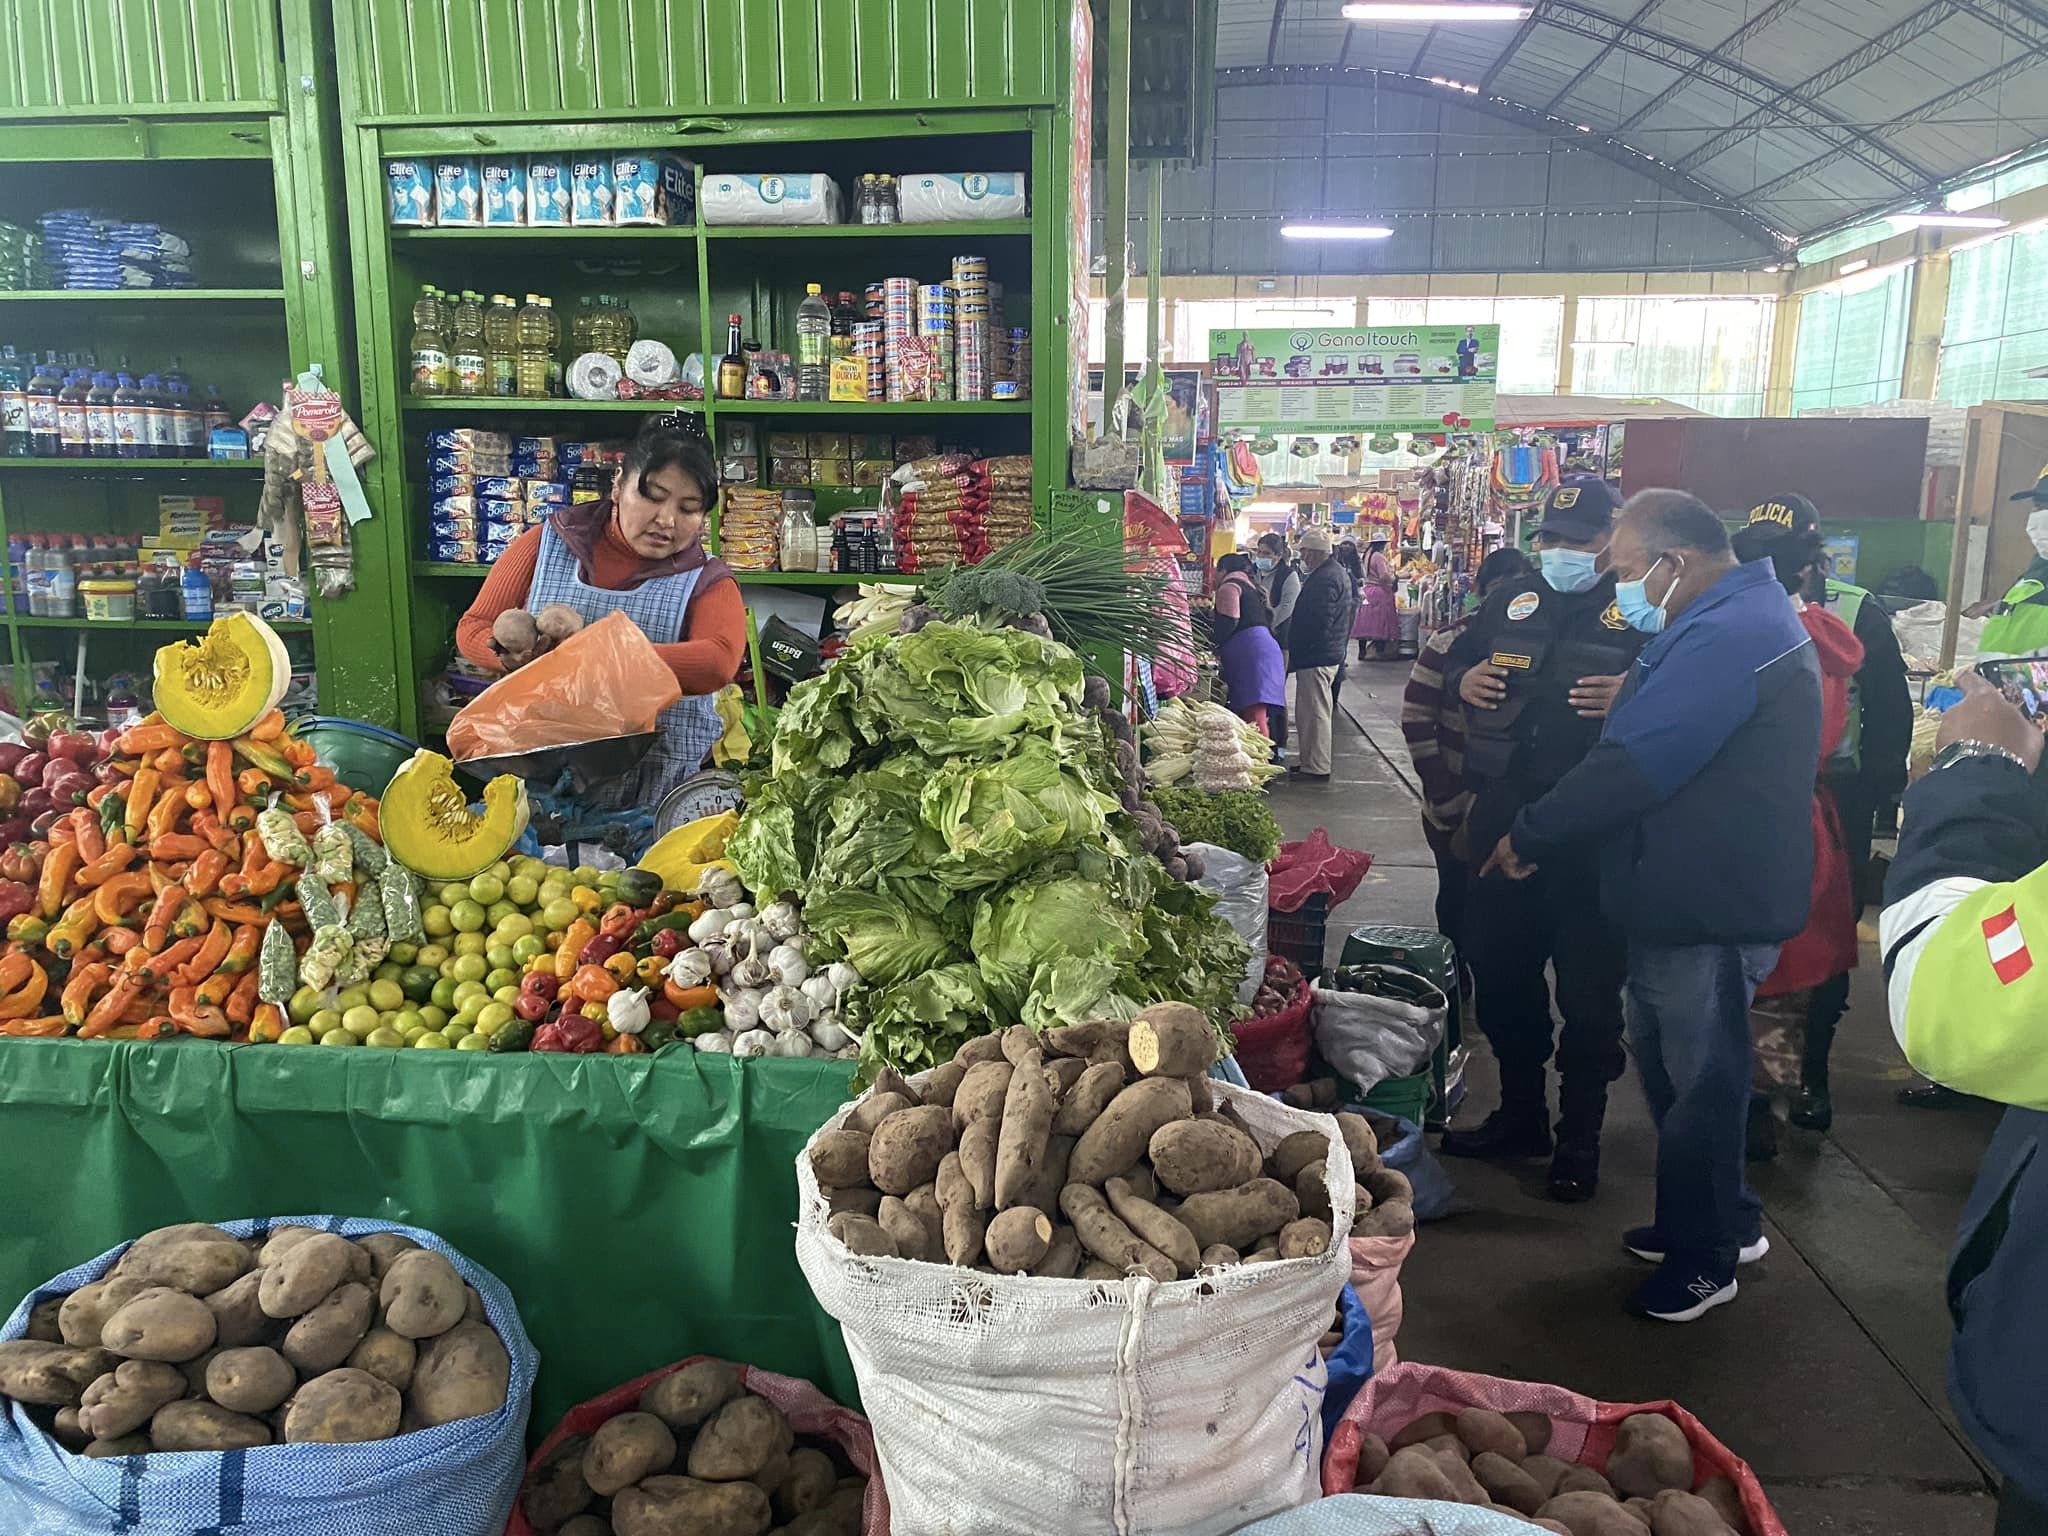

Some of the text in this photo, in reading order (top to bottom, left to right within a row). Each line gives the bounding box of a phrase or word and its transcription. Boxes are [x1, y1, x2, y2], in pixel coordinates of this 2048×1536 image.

[389, 163, 415, 175] Elite
[437, 165, 462, 176] Elite
[485, 167, 509, 178] Elite
[532, 165, 556, 177] Elite
[574, 164, 596, 176] Elite
[615, 162, 638, 176] Elite
[664, 166, 694, 202] Elite
[296, 405, 338, 418] Pomarola
[519, 441, 541, 455] Soda
[567, 446, 584, 458] Sod
[518, 463, 541, 478] Soda
[436, 476, 458, 493] Soda
[534, 485, 554, 498] Soda
[488, 504, 511, 517] Soda
[533, 505, 553, 518] Soda
[1750, 502, 1794, 528] POLICIA
[440, 543, 462, 558] Soda
[263, 606, 283, 619] NEKO
[695, 801, 701, 811] 1
[715, 795, 723, 805] 0
